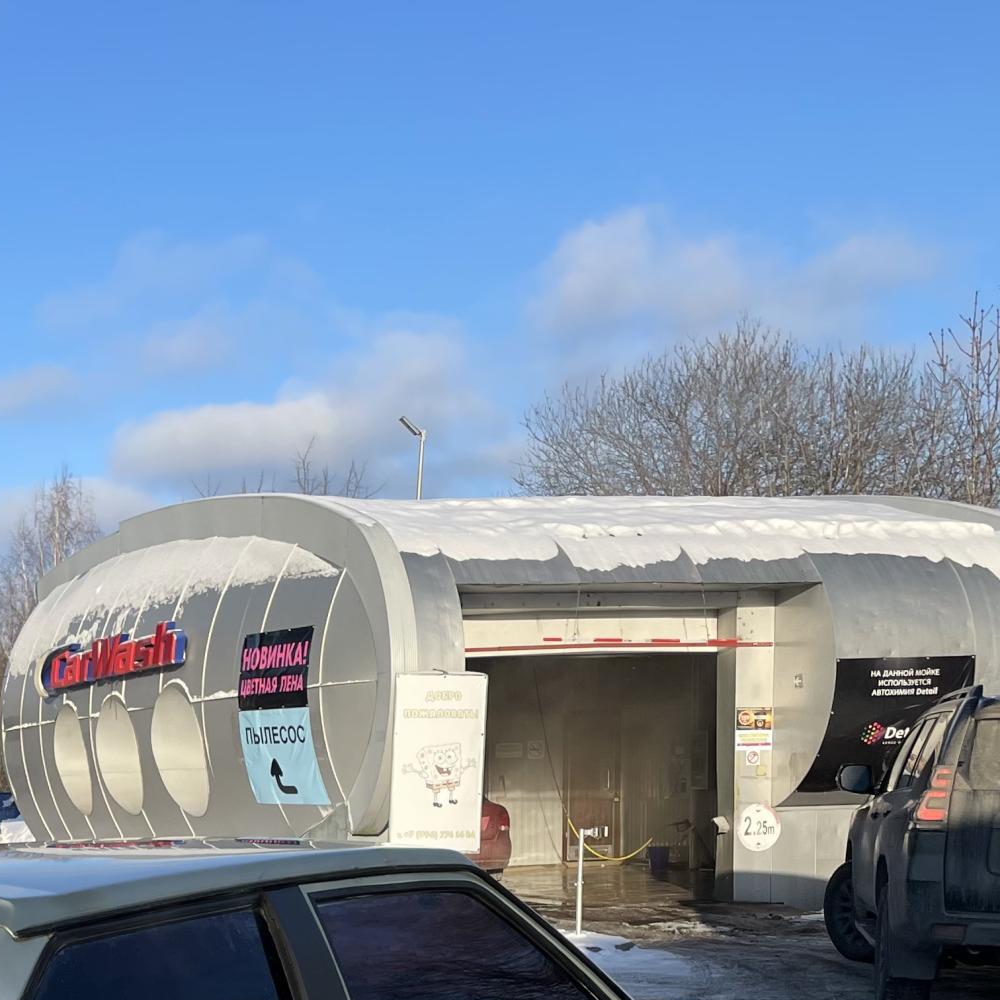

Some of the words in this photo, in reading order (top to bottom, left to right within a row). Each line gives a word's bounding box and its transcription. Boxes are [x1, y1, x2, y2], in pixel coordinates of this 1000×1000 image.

[42, 621, 182, 692] CarWash
[242, 641, 309, 671] НОВИНКА!
[882, 668, 914, 678] ДАННОЙ
[915, 667, 941, 676] МОЙКЕ
[240, 677, 278, 698] ЦВЕТНАЯ
[279, 674, 304, 692] ПЕНА
[871, 688, 915, 696] АВТОХИМИЯ
[916, 687, 939, 695] Detail
[878, 679, 932, 687] ИСПОЛЬЗУЕТСЯ
[245, 725, 306, 744] ПЫЛЕСОС
